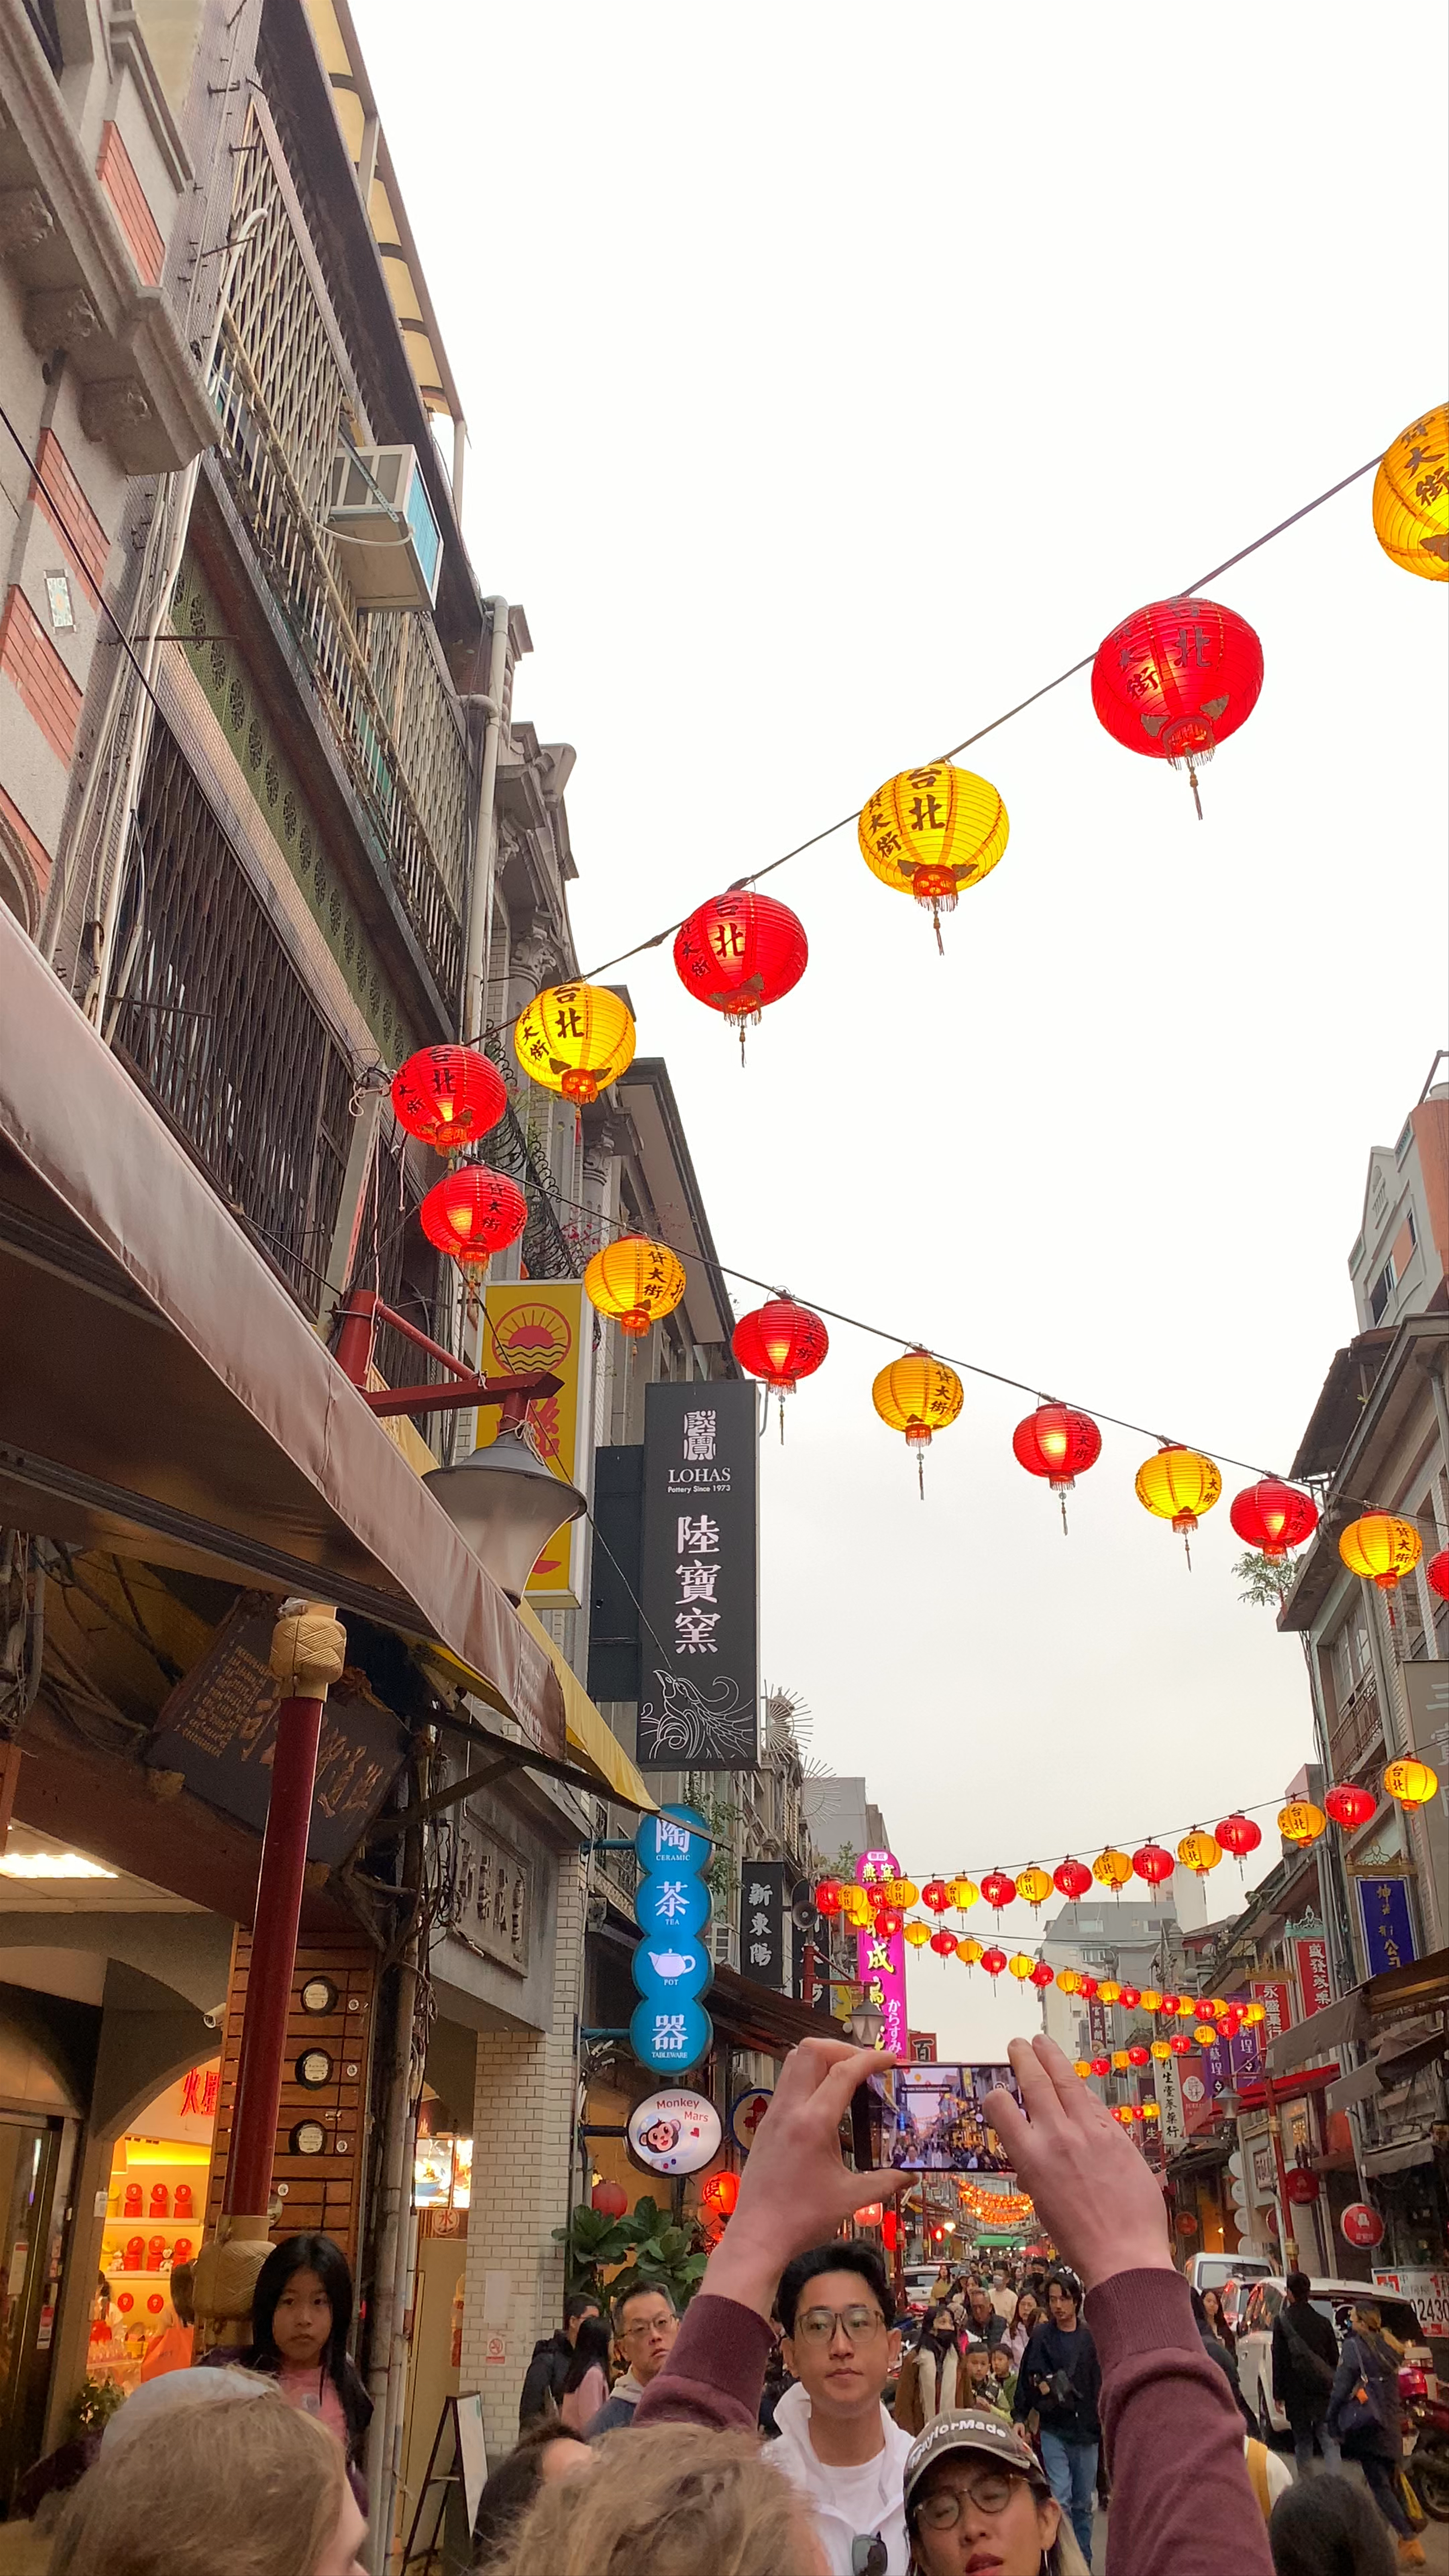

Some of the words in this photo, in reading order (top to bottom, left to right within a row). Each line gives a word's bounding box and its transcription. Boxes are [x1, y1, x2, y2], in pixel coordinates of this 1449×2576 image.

[907, 768, 945, 830] 台北
[712, 896, 745, 957] 台北
[553, 986, 585, 1038] 台北
[428, 1047, 456, 1094] 台北
[668, 1467, 731, 1483] LOHAS
[675, 1514, 721, 1654] 陸寶窯
[1392, 1766, 1404, 1791] 台北
[1292, 1807, 1306, 1829] 台北
[655, 1819, 690, 1853] 陶
[1186, 1839, 1200, 1862] 台北
[1101, 1854, 1113, 1874] 台北
[655, 1881, 690, 1917] 茶
[1023, 1873, 1034, 1895] 台北
[749, 1883, 773, 1966] 新東陽
[652, 2014, 688, 2050] 器
[888, 1999, 902, 2053] からすみ
[656, 2098, 700, 2110] Monkey
[684, 2111, 709, 2122] Mars
